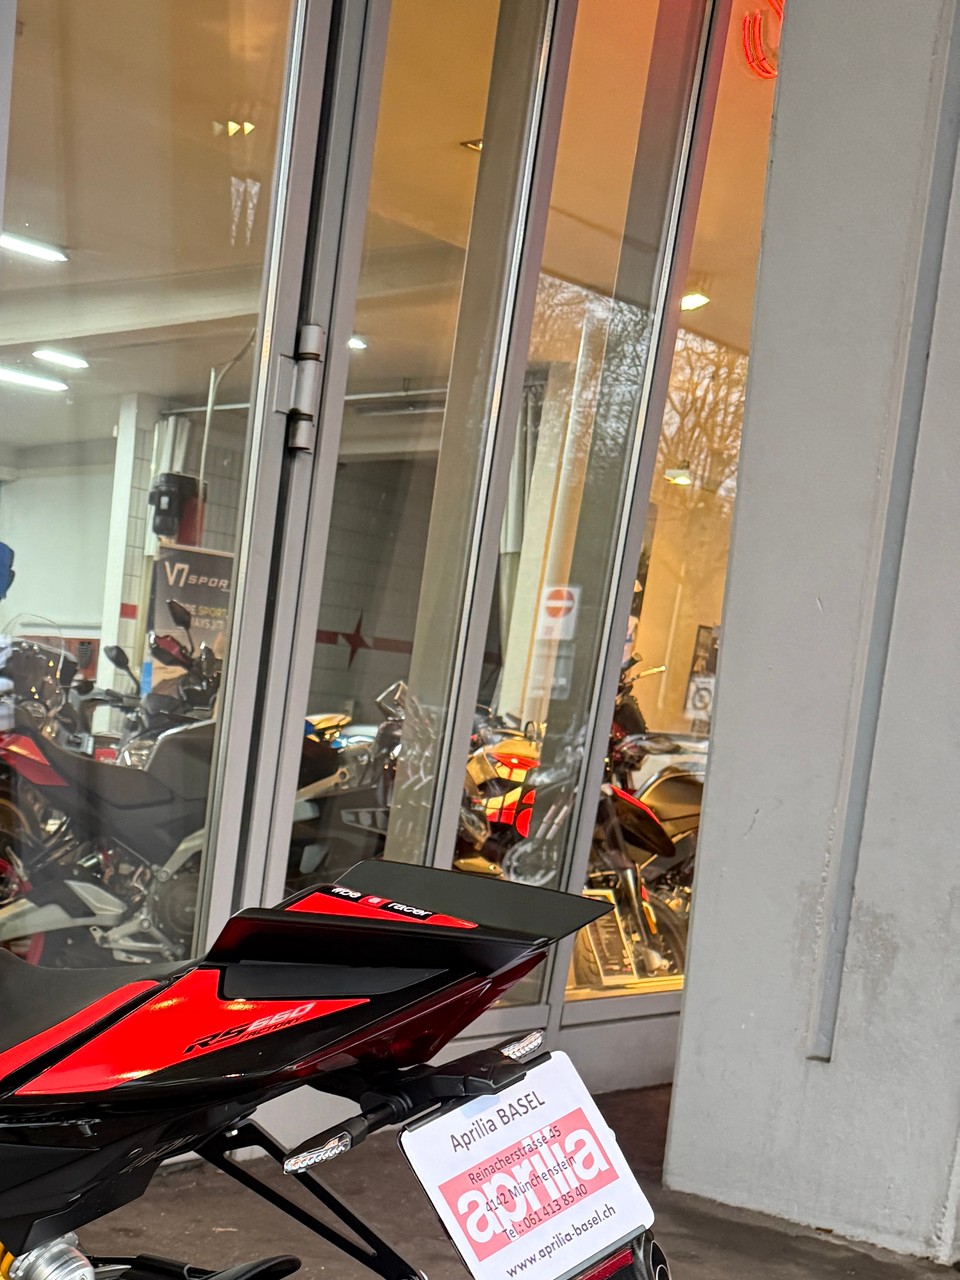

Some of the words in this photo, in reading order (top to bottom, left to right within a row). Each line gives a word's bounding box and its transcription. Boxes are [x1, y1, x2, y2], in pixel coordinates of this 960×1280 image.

[165, 561, 190, 587] V7
[188, 574, 229, 589] SPOR
[387, 902, 433, 917] racer
[450, 1117, 498, 1153] Aprilia
[496, 1091, 546, 1126] BASEL
[456, 1122, 610, 1243] aprilia
[468, 1134, 549, 1185] Reinacherstrasse
[549, 1125, 562, 1140] 45
[485, 1192, 509, 1213] 4142
[508, 1154, 577, 1200] Münchenstein
[502, 1224, 525, 1241] Tel.:
[523, 1214, 542, 1230] 061
[543, 1199, 562, 1217] 413
[562, 1191, 575, 1206] 85
[575, 1183, 589, 1198] 40
[506, 1203, 616, 1278] www.aprilia-basel.ch
